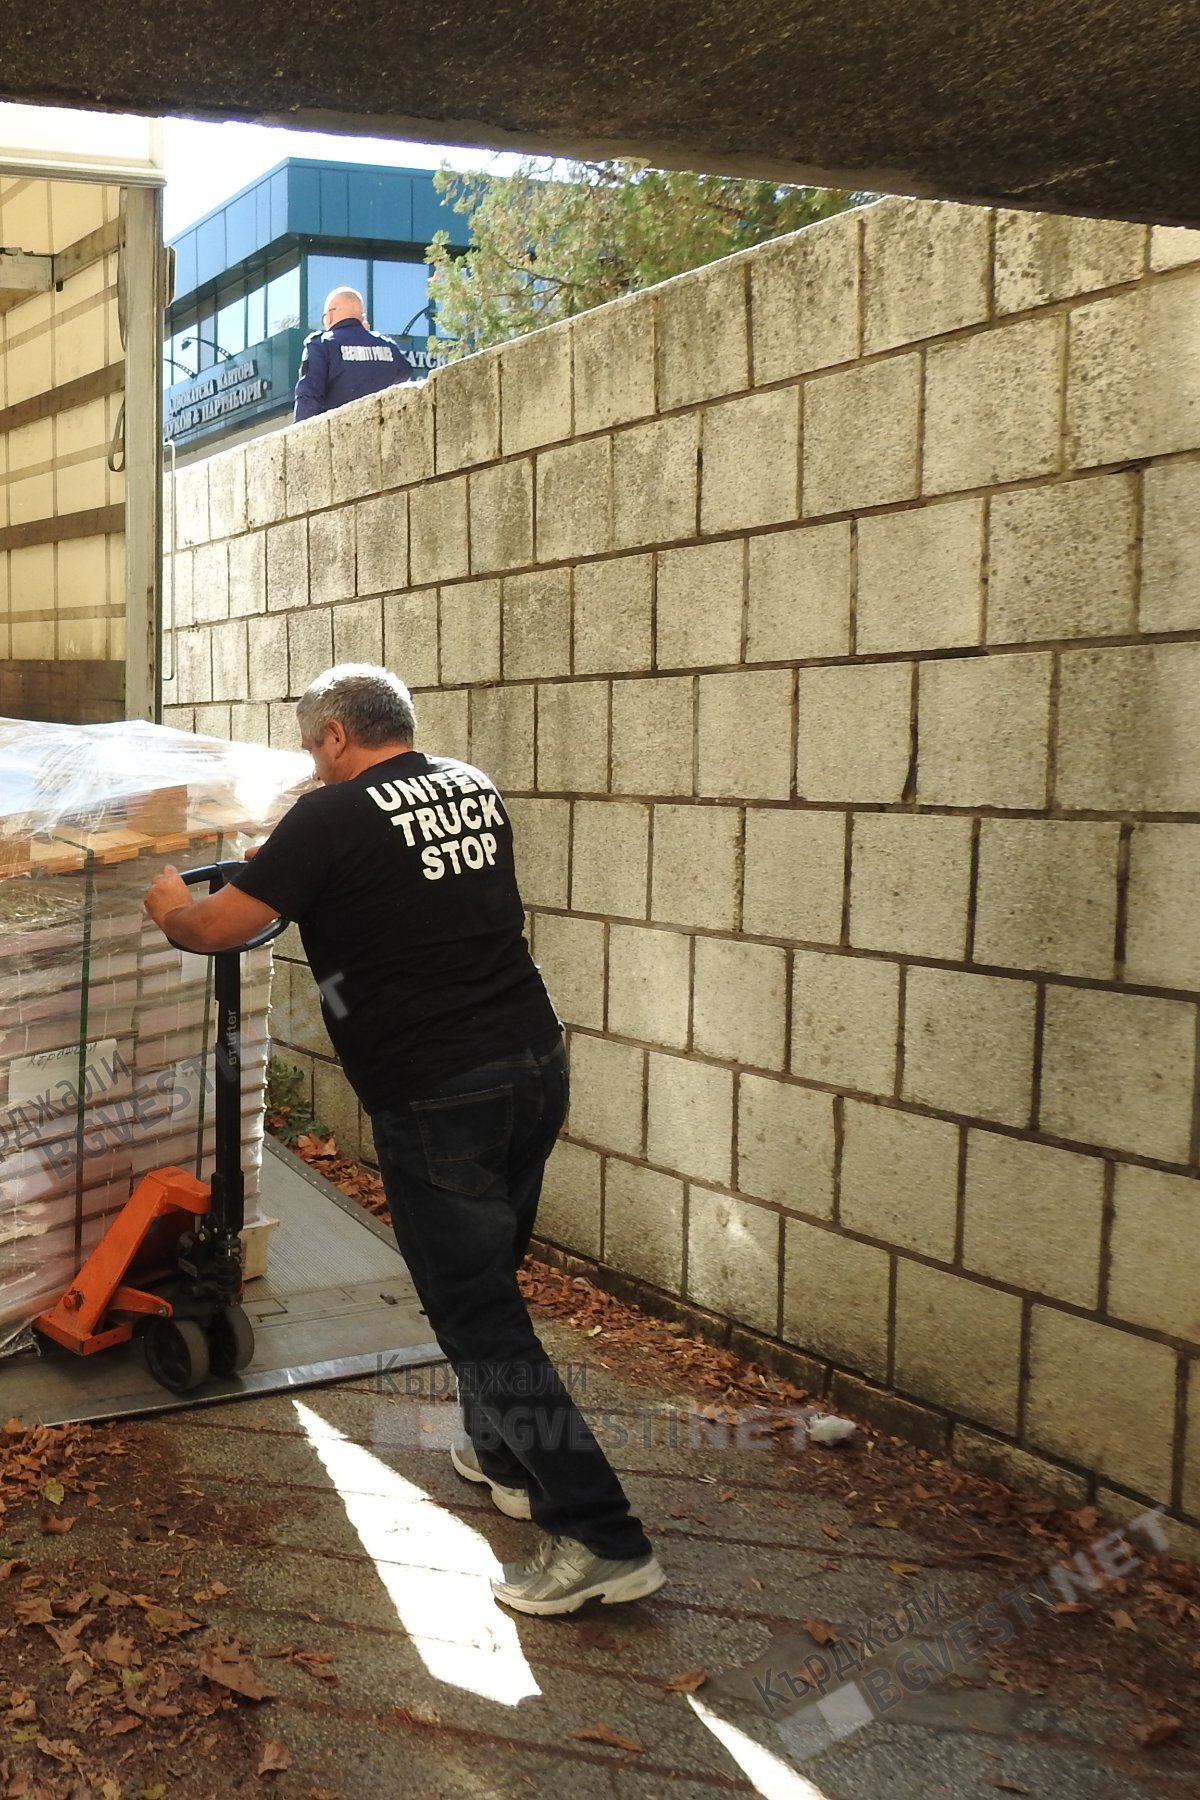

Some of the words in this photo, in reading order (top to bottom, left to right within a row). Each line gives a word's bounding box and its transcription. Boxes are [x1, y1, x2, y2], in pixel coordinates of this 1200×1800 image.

[217, 360, 256, 392] КАНТОРА
[201, 379, 262, 422] ПАРТНЬОРИ
[365, 768, 493, 811] UNITED
[390, 794, 504, 847] TRUCK
[420, 832, 498, 881] STOP
[228, 1050, 237, 1067] BT
